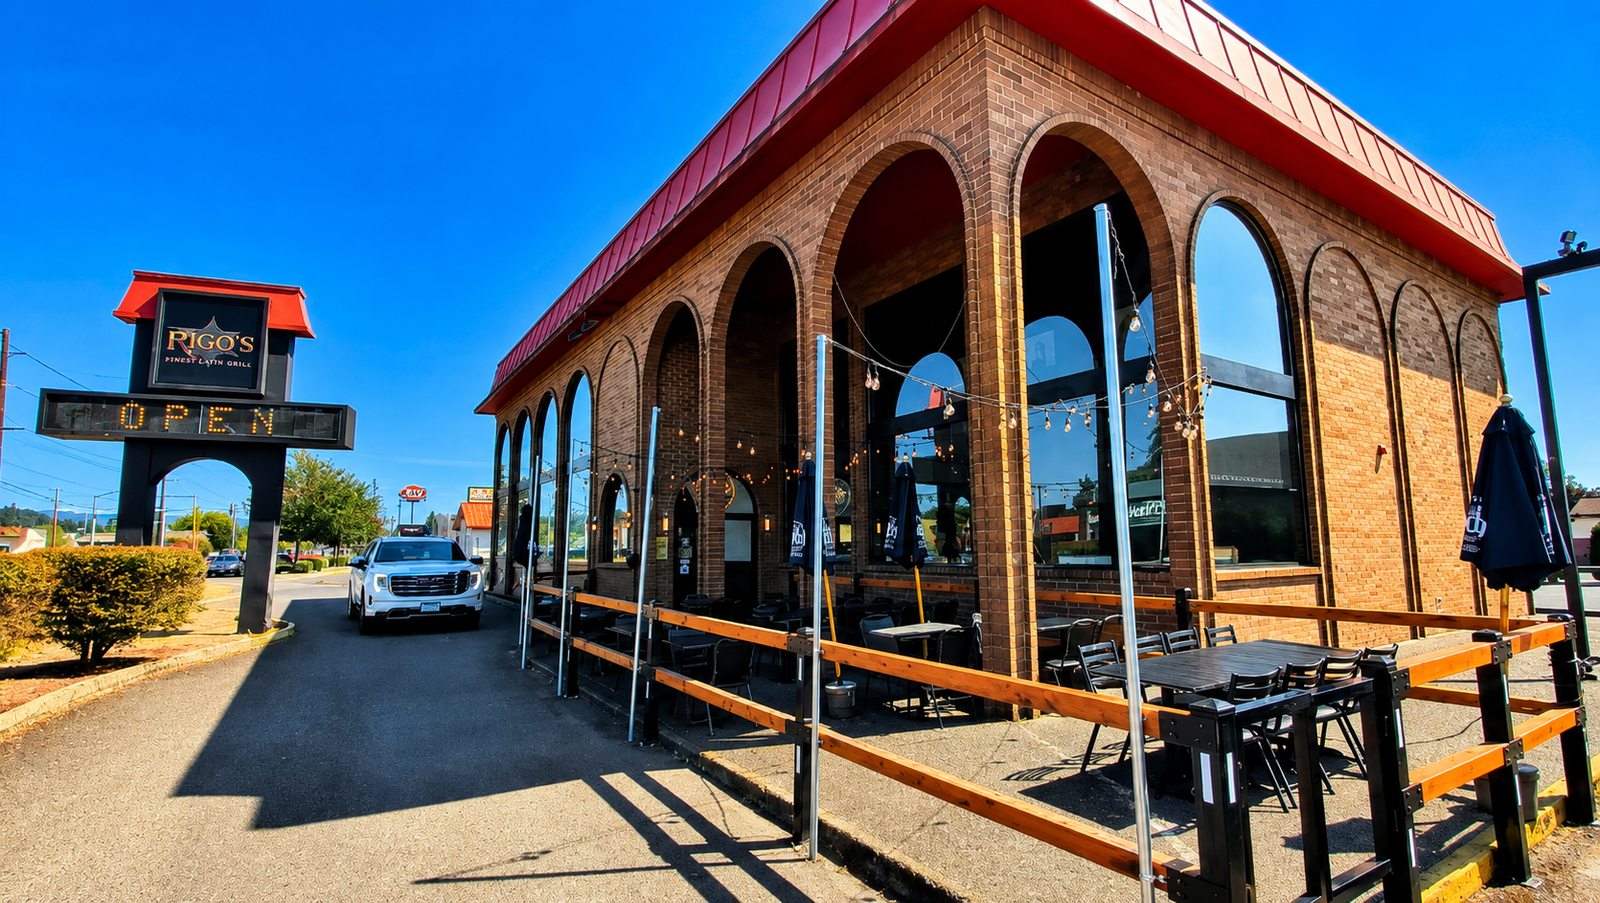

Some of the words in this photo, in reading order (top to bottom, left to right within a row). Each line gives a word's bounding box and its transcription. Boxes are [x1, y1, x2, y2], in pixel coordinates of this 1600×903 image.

[166, 330, 254, 357] RIGO'S
[165, 356, 196, 364] FINEST
[198, 357, 224, 366] LATIN
[227, 360, 252, 368] GRILL
[120, 403, 274, 435] OPEN
